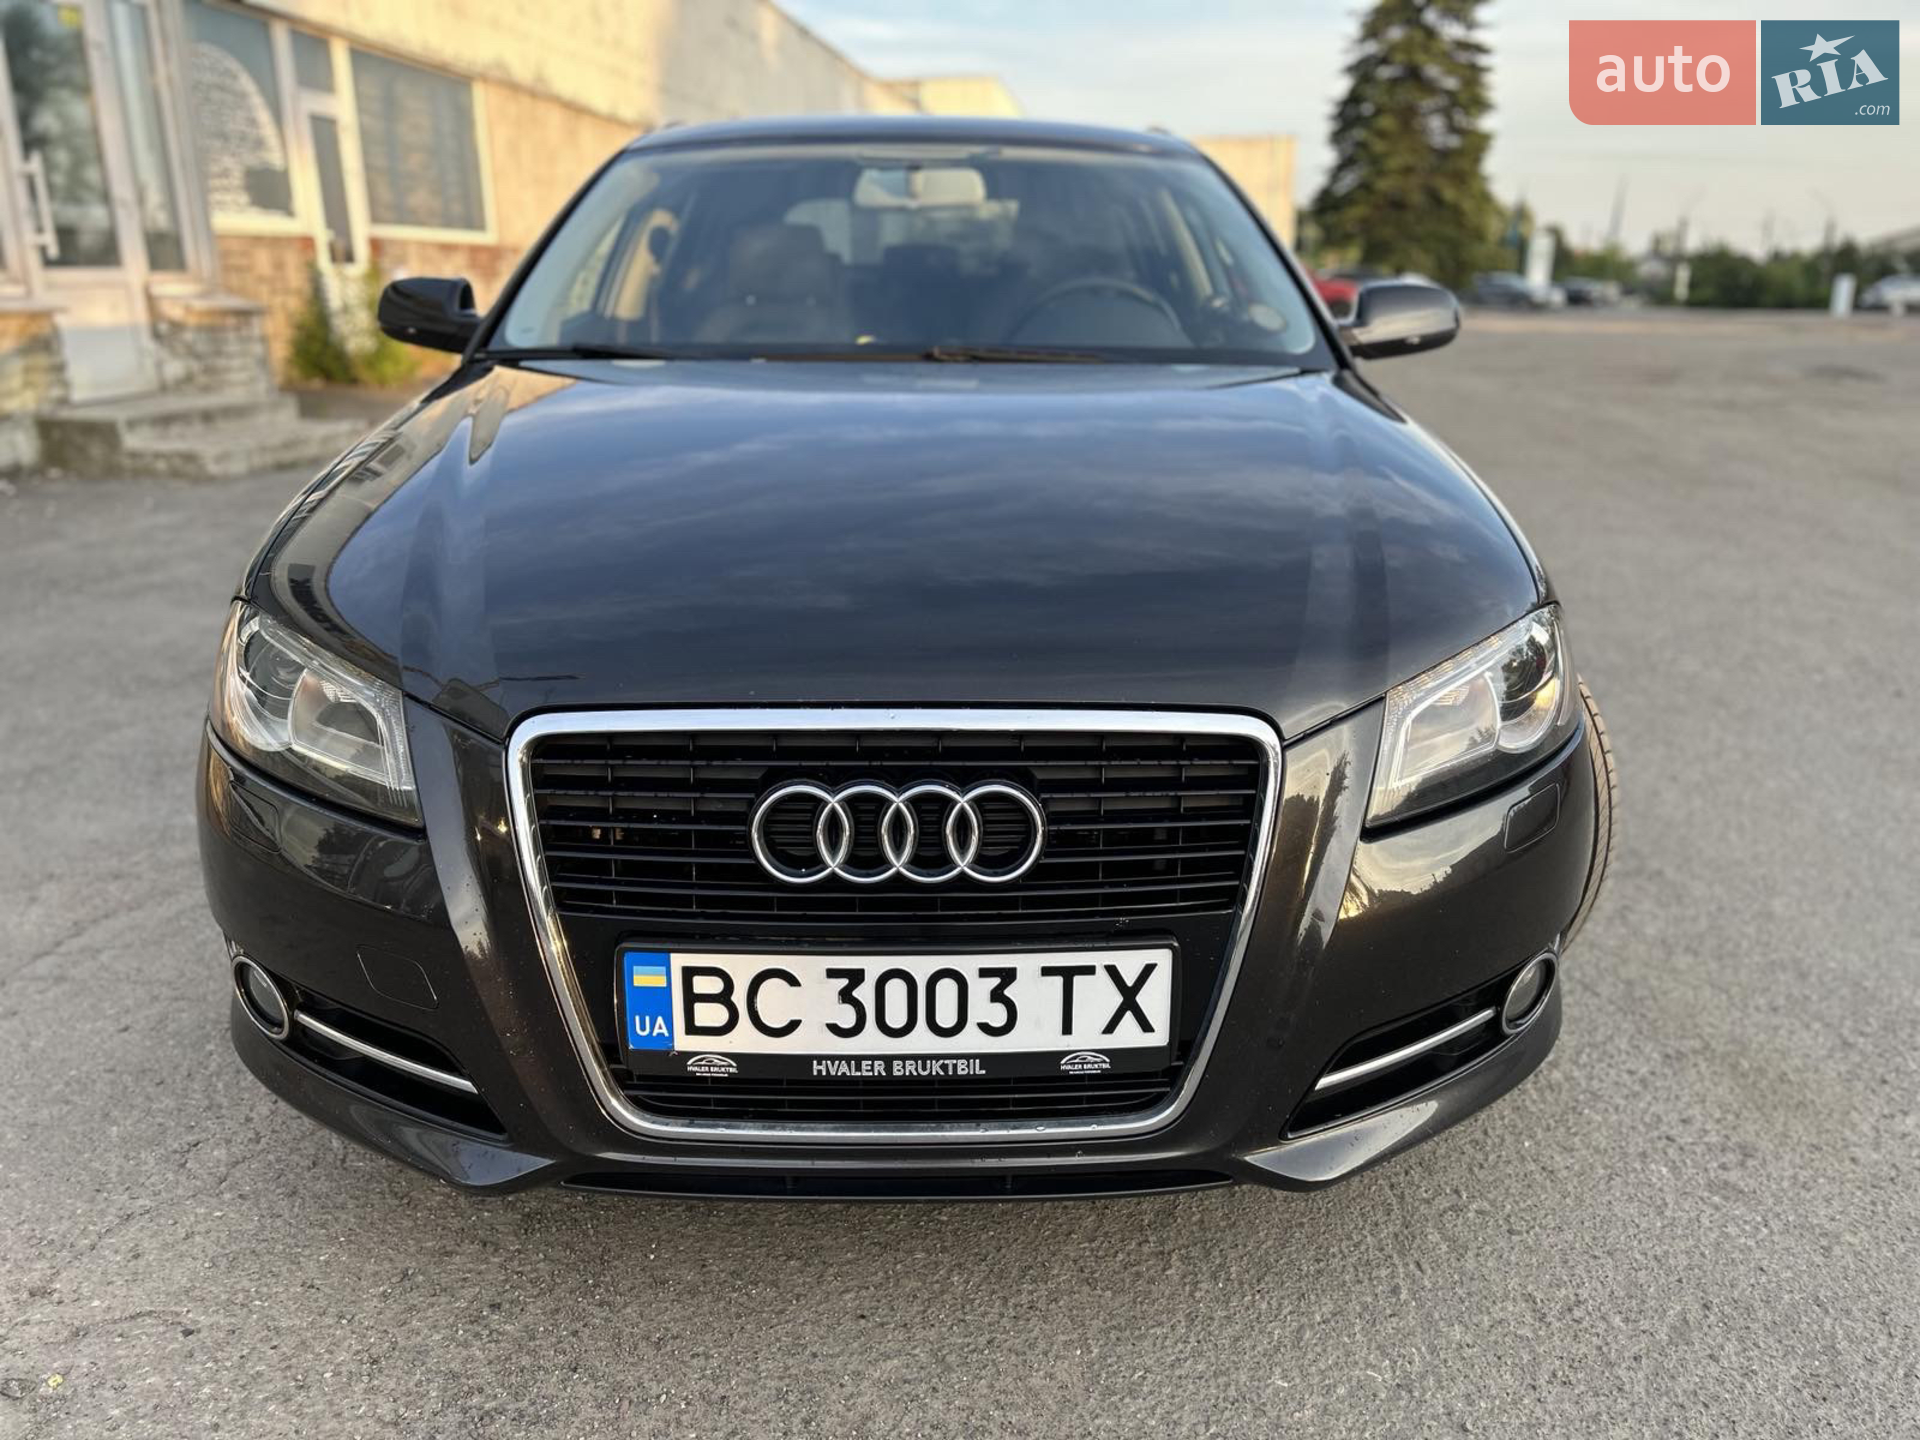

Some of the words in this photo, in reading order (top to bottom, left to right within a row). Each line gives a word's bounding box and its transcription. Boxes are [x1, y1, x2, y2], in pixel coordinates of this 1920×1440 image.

[681, 965, 803, 1038] BC
[825, 967, 1018, 1038] 3003
[1041, 963, 1158, 1036] TX
[634, 1014, 670, 1038] UA
[812, 1059, 886, 1076] HVALER
[892, 1058, 986, 1075] BRUKTBIL
